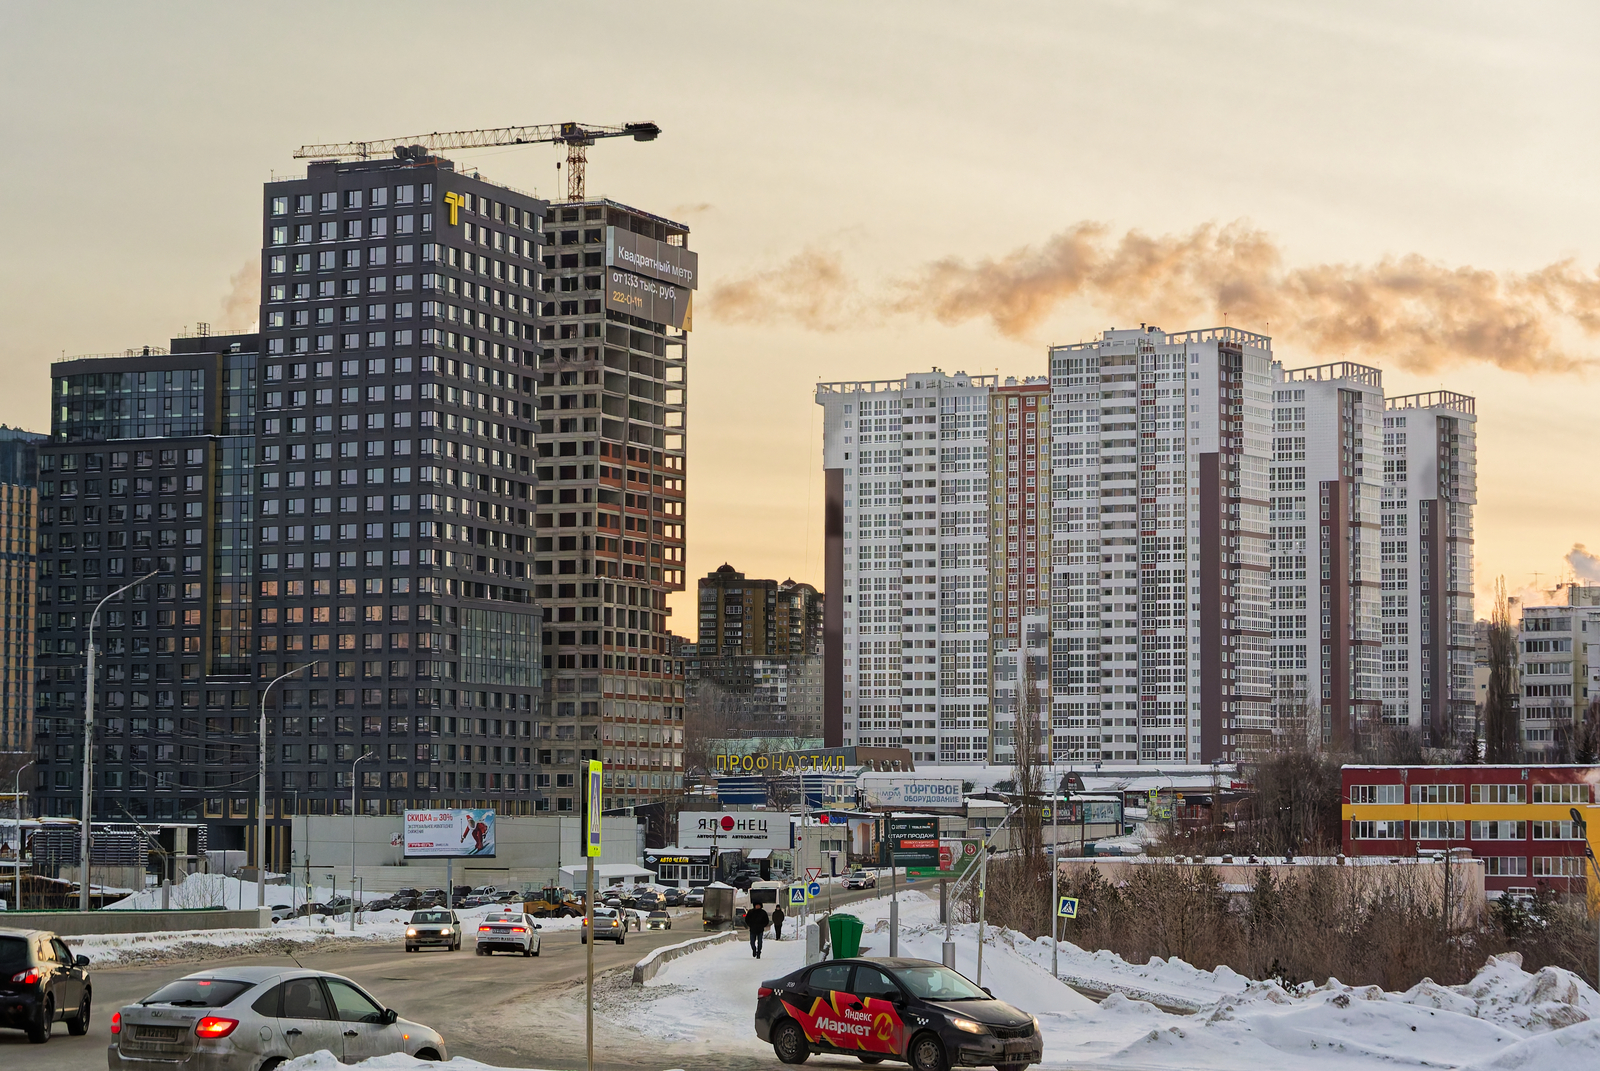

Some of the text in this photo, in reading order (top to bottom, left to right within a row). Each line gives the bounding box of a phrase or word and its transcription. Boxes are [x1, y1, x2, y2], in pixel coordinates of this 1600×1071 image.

[618, 245, 693, 283] Квадратный метр
[612, 272, 623, 284] от
[659, 286, 677, 300] руб.
[716, 755, 846, 772] ПРОФНАСТИЛ
[903, 784, 959, 795] ТОРГОВОЕ
[903, 795, 959, 803] ОБОРУДОВАНИЕ
[406, 813, 432, 823] СКИДКА
[844, 1008, 873, 1022] Яндекс
[815, 1016, 872, 1037] Маркет
